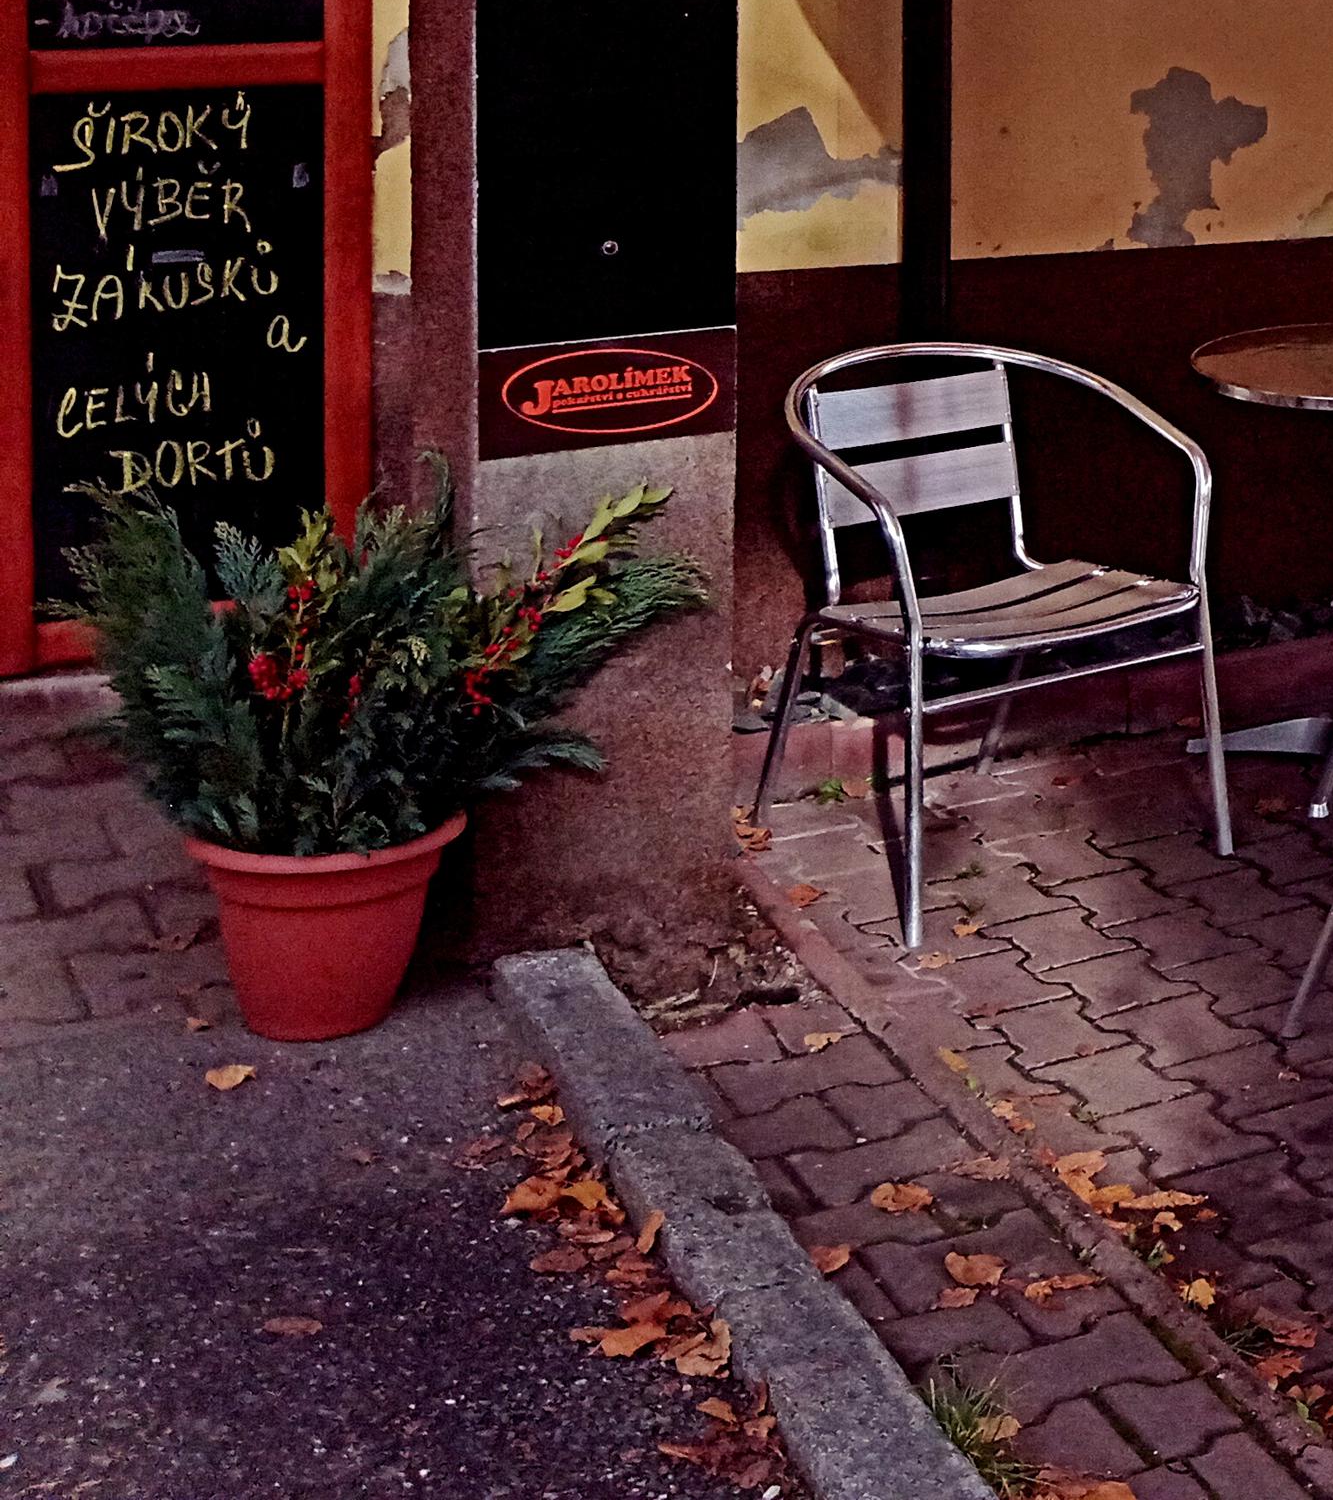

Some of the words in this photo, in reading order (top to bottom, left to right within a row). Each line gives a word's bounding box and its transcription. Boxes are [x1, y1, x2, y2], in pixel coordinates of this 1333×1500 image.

[53, 91, 251, 172] ŠIROKÝ
[92, 160, 251, 240] VÝBĚR
[51, 242, 279, 331] ZÁKUSKŮ
[521, 366, 693, 416] JAROLÍMEK
[109, 417, 276, 494] DORTŮ
